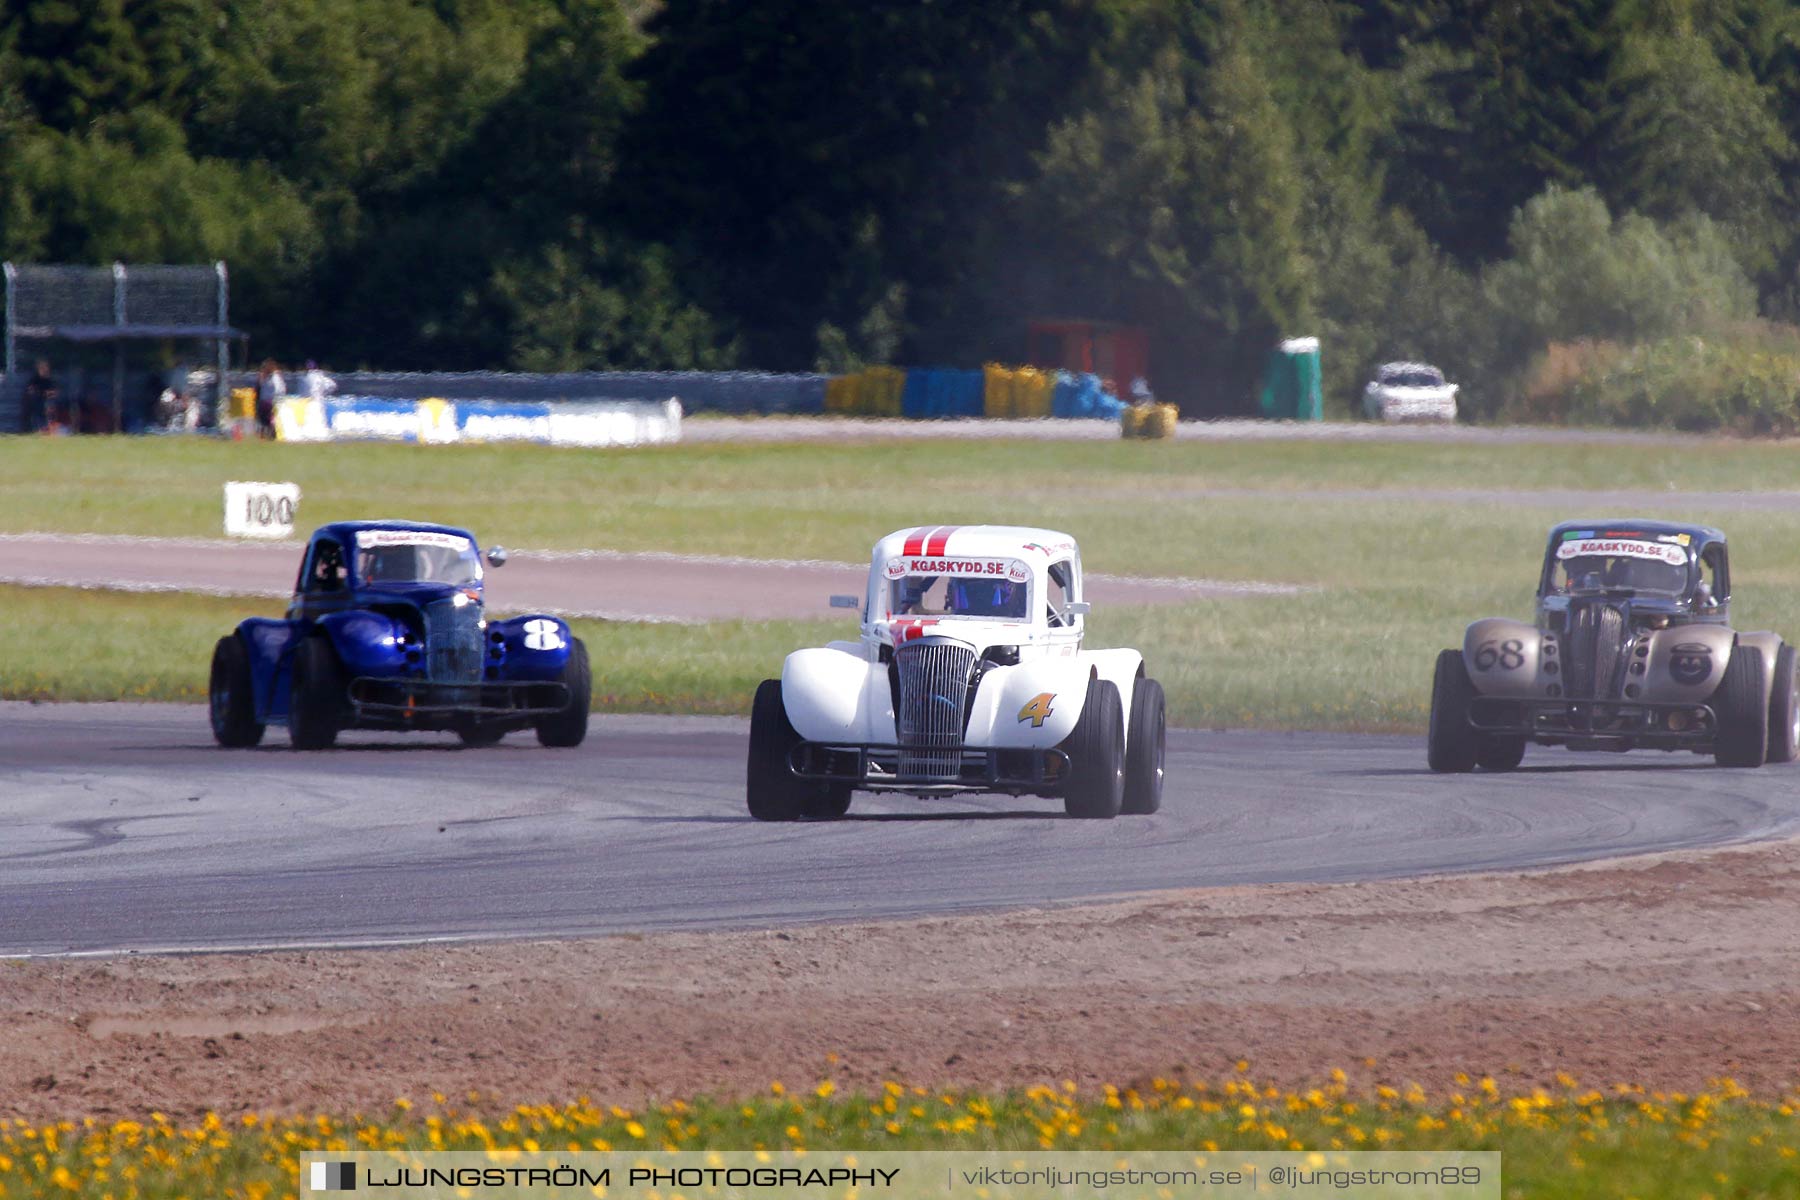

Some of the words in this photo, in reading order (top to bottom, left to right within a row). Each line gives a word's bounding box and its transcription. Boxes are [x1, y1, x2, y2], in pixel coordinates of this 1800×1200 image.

[245, 494, 294, 526] 100
[1580, 542, 1662, 556] KGASKYDD.SE
[911, 559, 1005, 575] KGASKYDD.SE
[523, 618, 561, 651] 8
[1474, 638, 1525, 673] 68
[1017, 692, 1058, 729] 4
